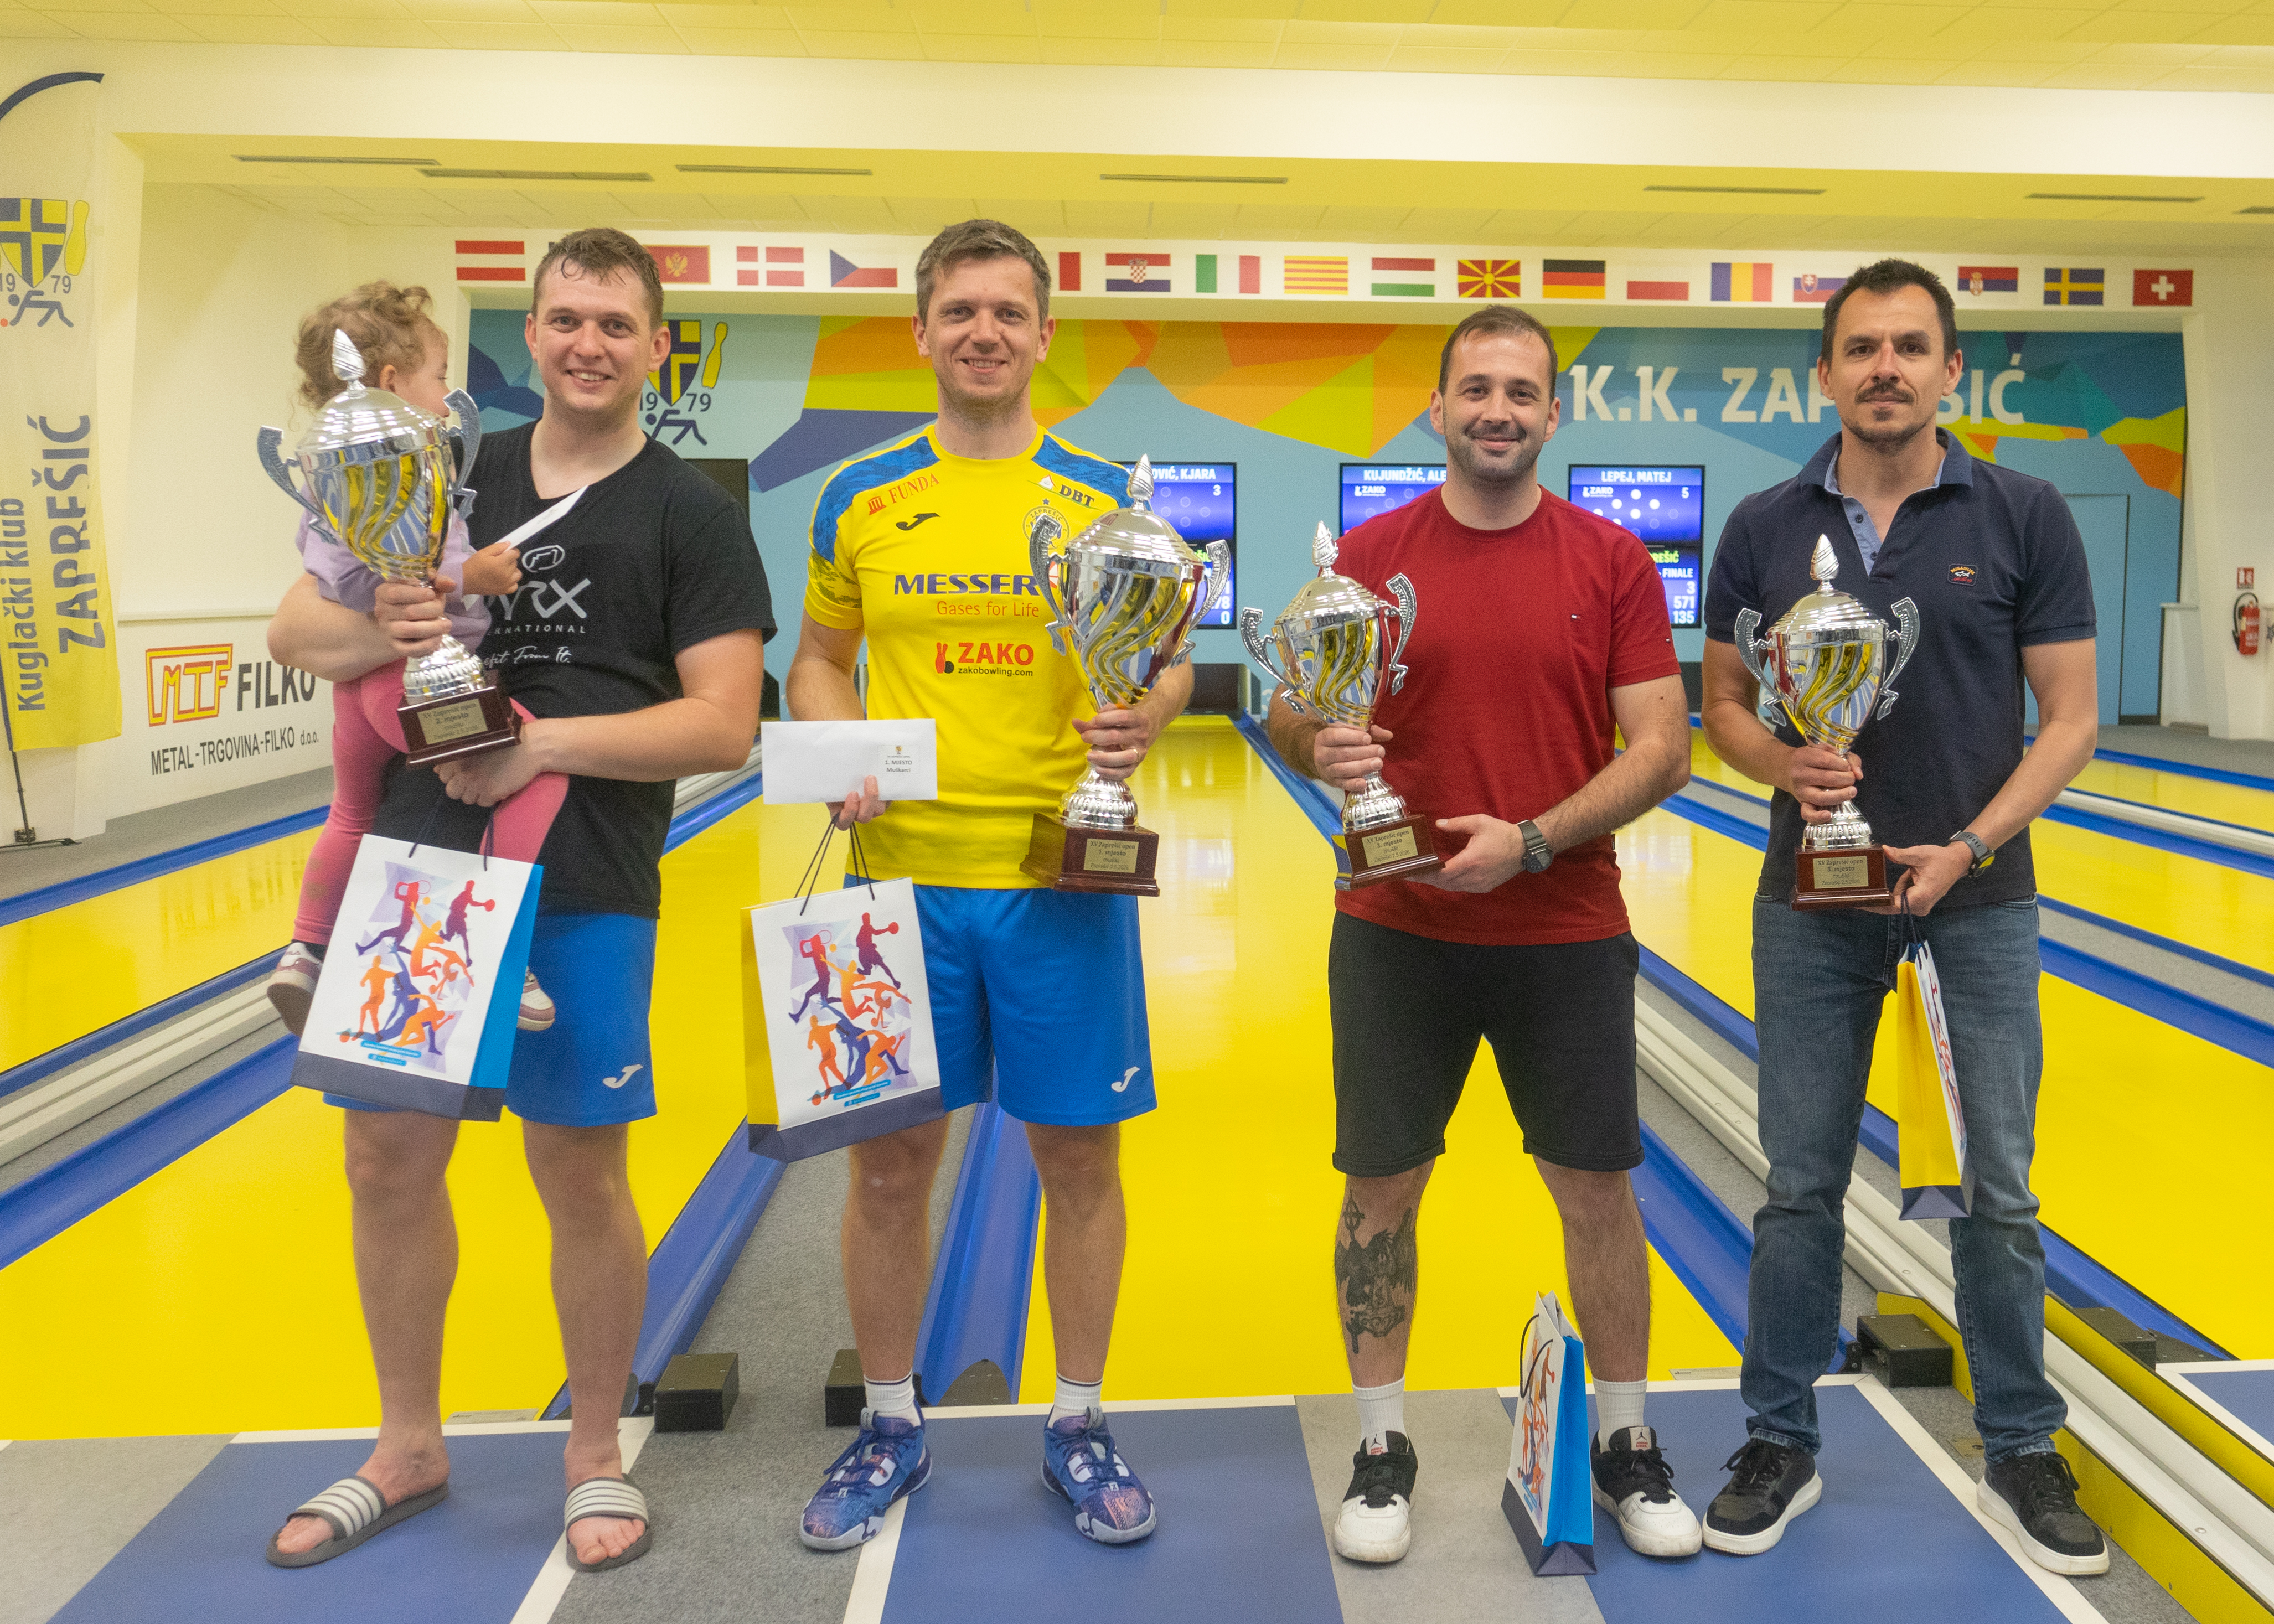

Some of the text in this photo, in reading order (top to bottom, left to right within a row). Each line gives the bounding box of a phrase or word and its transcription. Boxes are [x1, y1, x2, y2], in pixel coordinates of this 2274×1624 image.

[1569, 364, 1697, 421] K.K.
[686, 392, 711, 412] 79
[1180, 468, 1216, 480] KJARA
[1363, 467, 1447, 483] KUJUNDŽIĆ, ALE
[1601, 470, 1635, 484] LEPEJ,
[888, 473, 940, 504] FUNDA
[1212, 484, 1221, 496] 3
[1362, 485, 1386, 494] ZAKO
[1681, 487, 1689, 499] 5
[1058, 484, 1095, 508] DBT
[27, 414, 106, 654] ZAPREŠIĆ
[1649, 550, 1679, 563] REŠIĆ
[1662, 568, 1694, 578] FINALE
[894, 573, 1041, 596] MESSER
[1686, 580, 1696, 594] 3
[937, 601, 1040, 617] Gases for Life
[1673, 595, 1695, 609] 571
[1673, 610, 1695, 624] 135
[487, 625, 586, 636] RNATIONAL
[958, 642, 1035, 666] ZAKO
[958, 666, 1034, 677] zakobowling.com
